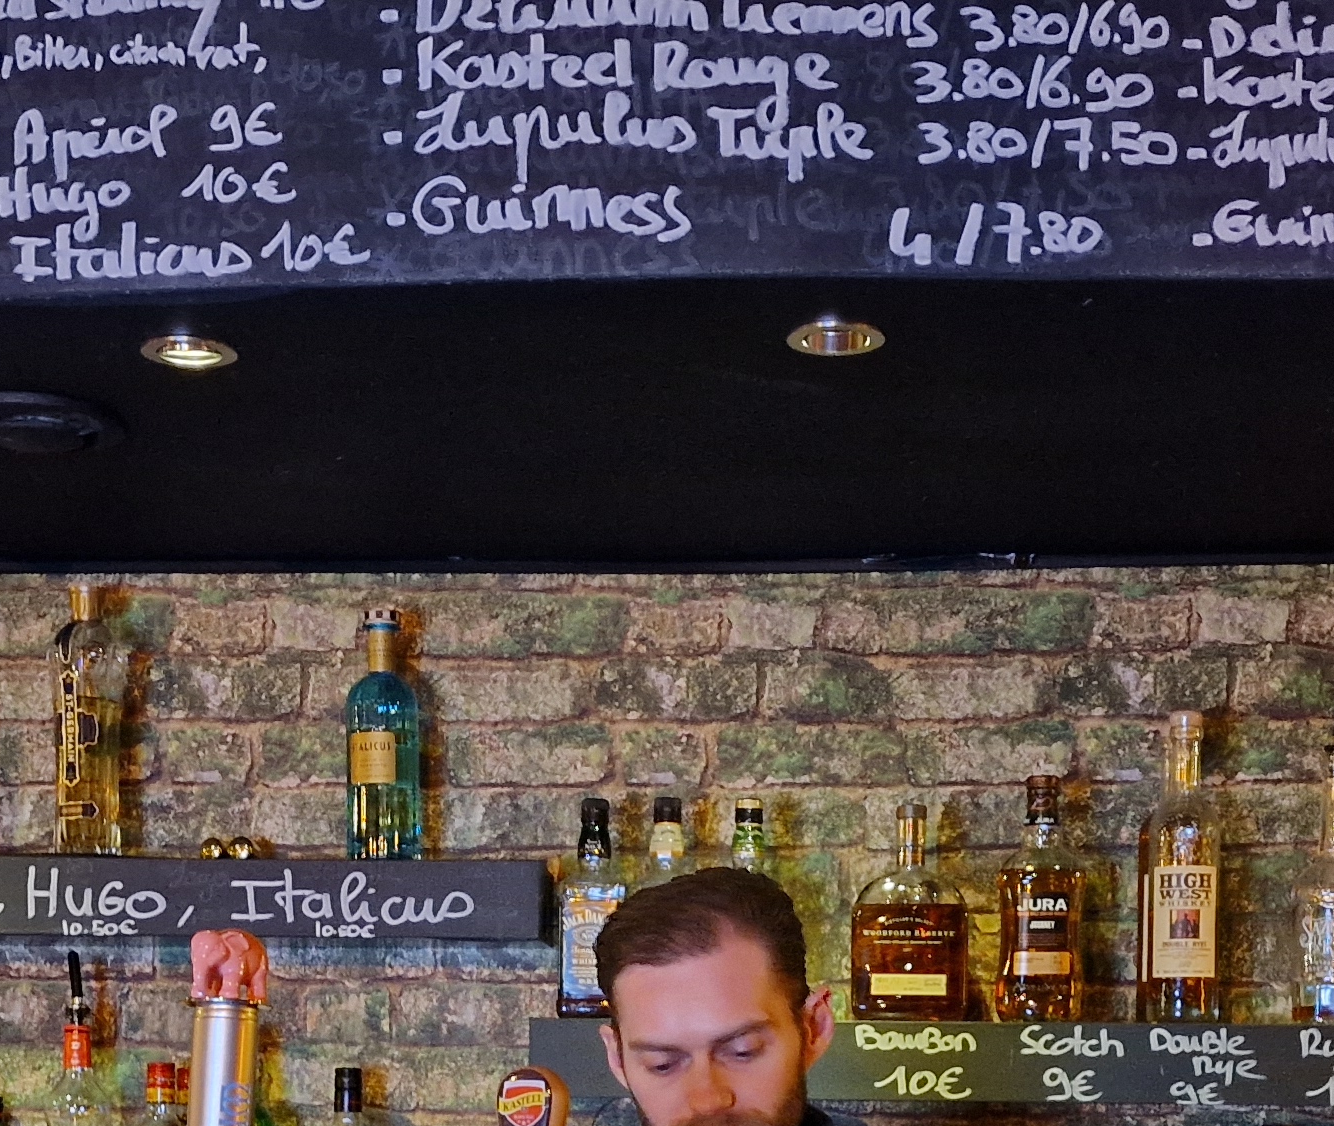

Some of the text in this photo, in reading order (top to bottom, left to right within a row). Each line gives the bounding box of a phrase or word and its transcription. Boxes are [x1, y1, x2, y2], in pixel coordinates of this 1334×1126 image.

[975, 3, 1168, 54] 3.80/6.90
[418, 34, 1153, 131] Kasteel Rouge 3.80/6.90
[209, 103, 283, 151] 9€
[414, 90, 1178, 183] Lupulus Triple 3.80/7.50
[182, 163, 296, 201] 10€
[412, 175, 691, 242] Guinness
[9, 220, 370, 282] Italicus 10€
[230, 868, 475, 927] Italicus
[1159, 873, 1212, 889] HIGH
[1159, 889, 1213, 900] WEST
[1018, 898, 1068, 912] JURA
[1020, 1025, 1124, 1059] Scotch
[875, 1067, 972, 1099] 10€
[1043, 1066, 1103, 1102] 9€
[1170, 1081, 1227, 1105] 9€
[1193, 1055, 1267, 1085] Rye
[503, 1093, 545, 1113] KASTEEL
